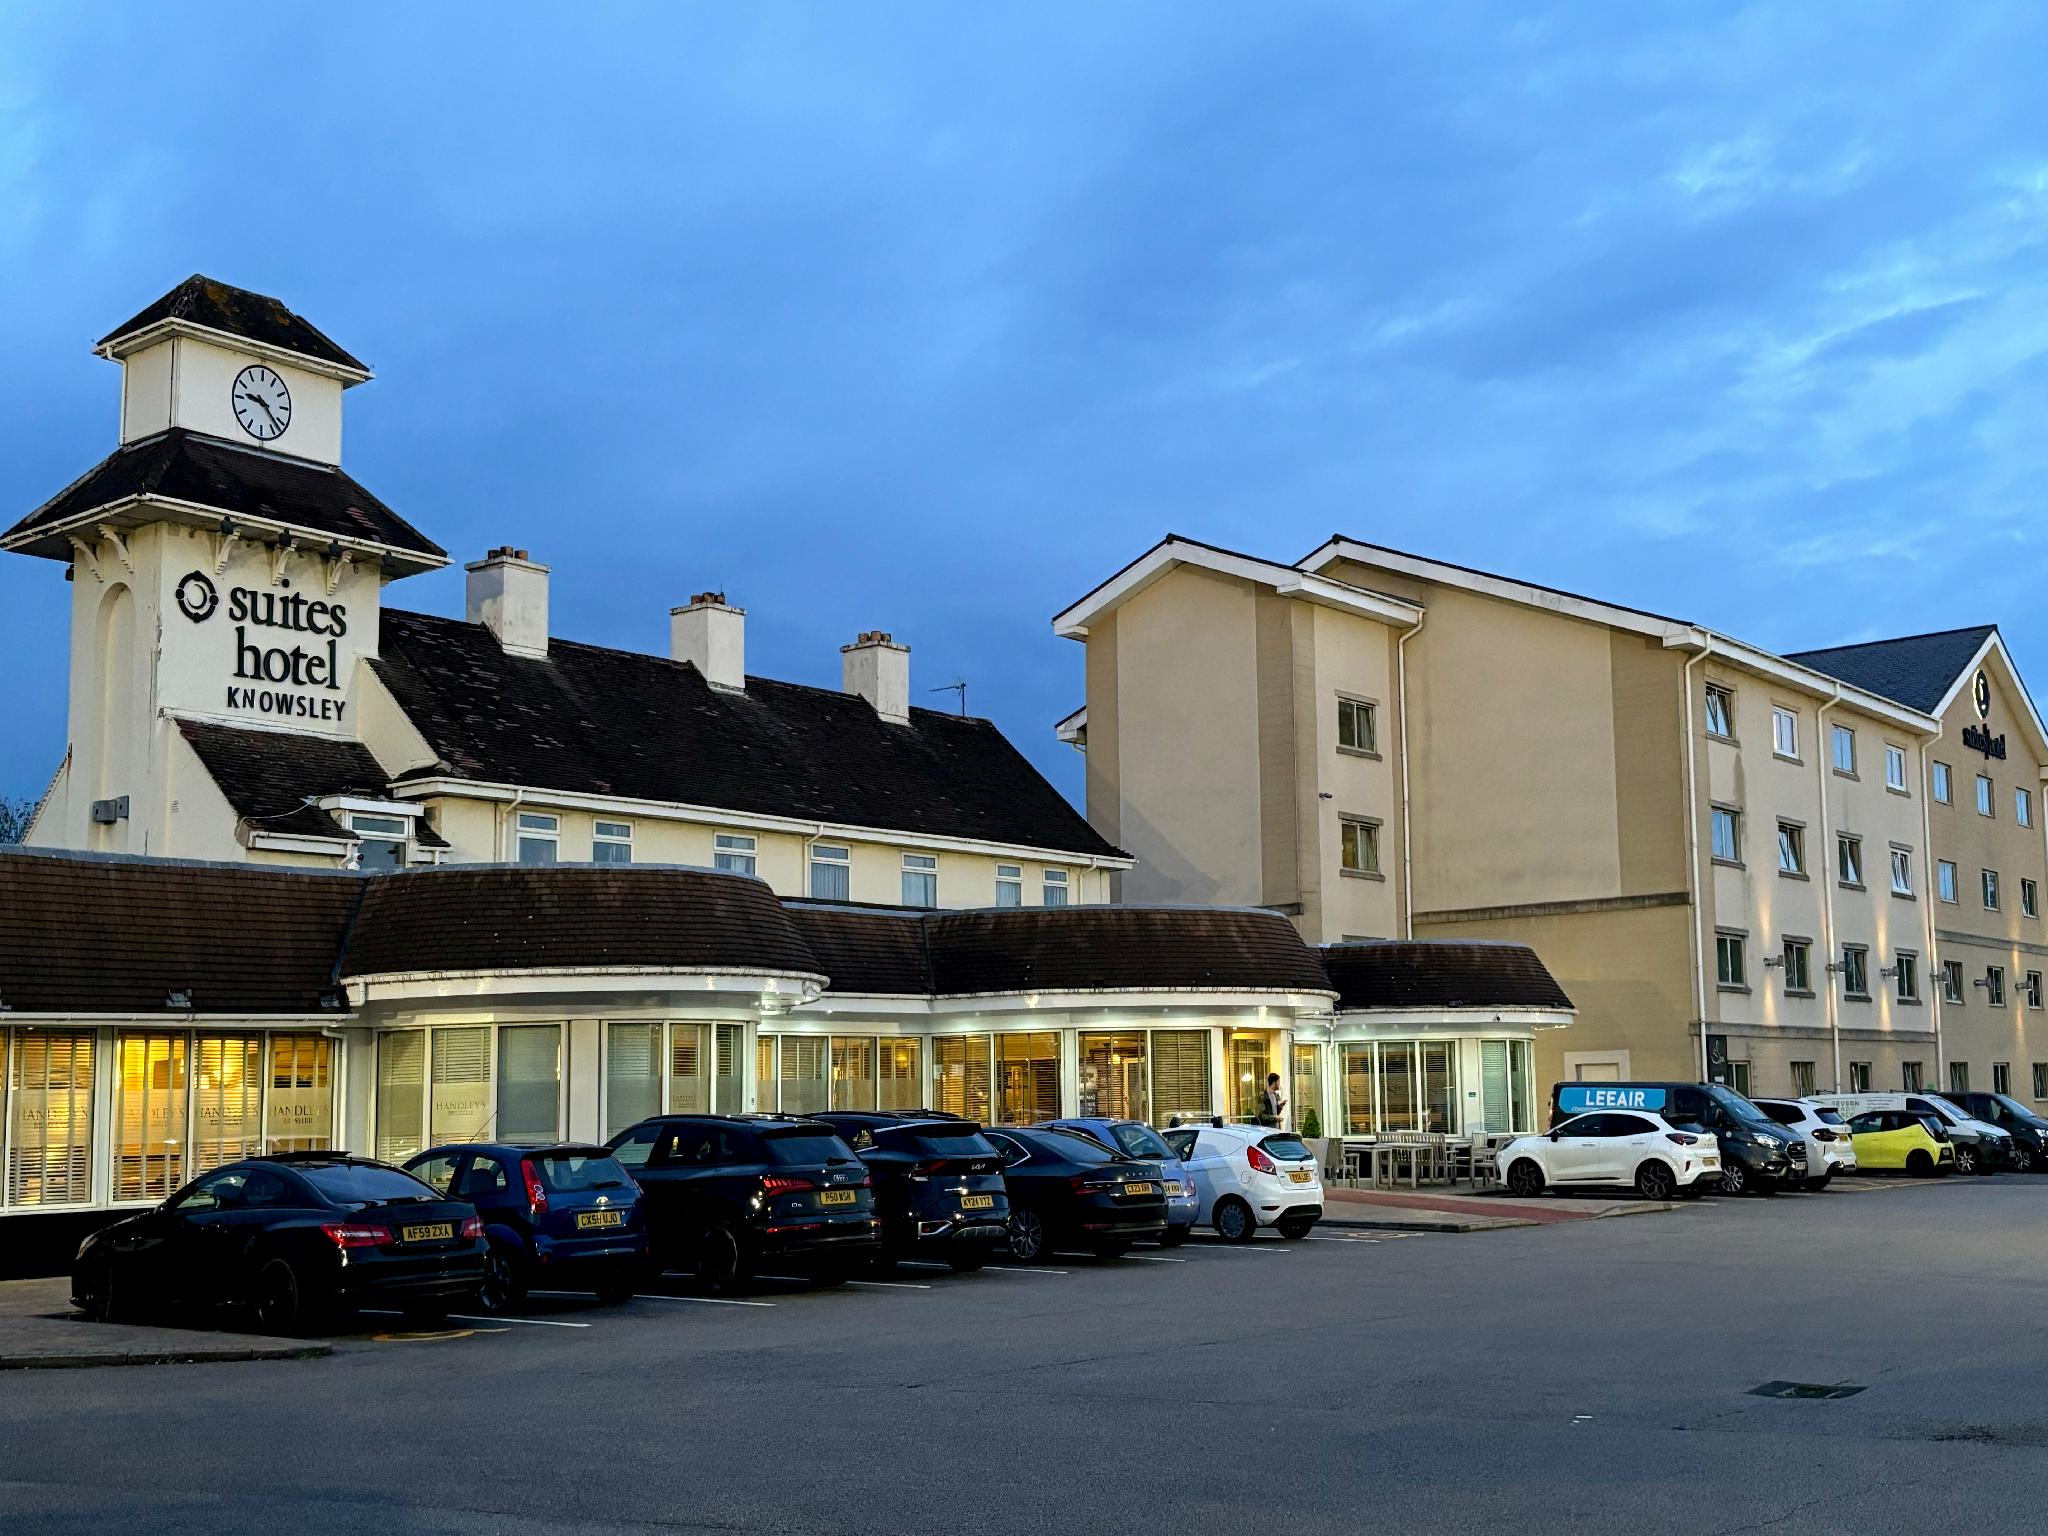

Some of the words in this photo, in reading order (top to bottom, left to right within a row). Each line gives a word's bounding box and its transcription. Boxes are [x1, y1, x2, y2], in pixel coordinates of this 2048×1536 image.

[229, 578, 347, 638] suites
[233, 626, 341, 690] hotel
[227, 686, 346, 722] KNOWSLEY
[1585, 1090, 1645, 1107] LEEAIR
[407, 1227, 430, 1239] AF59
[432, 1225, 450, 1237] ZXA
